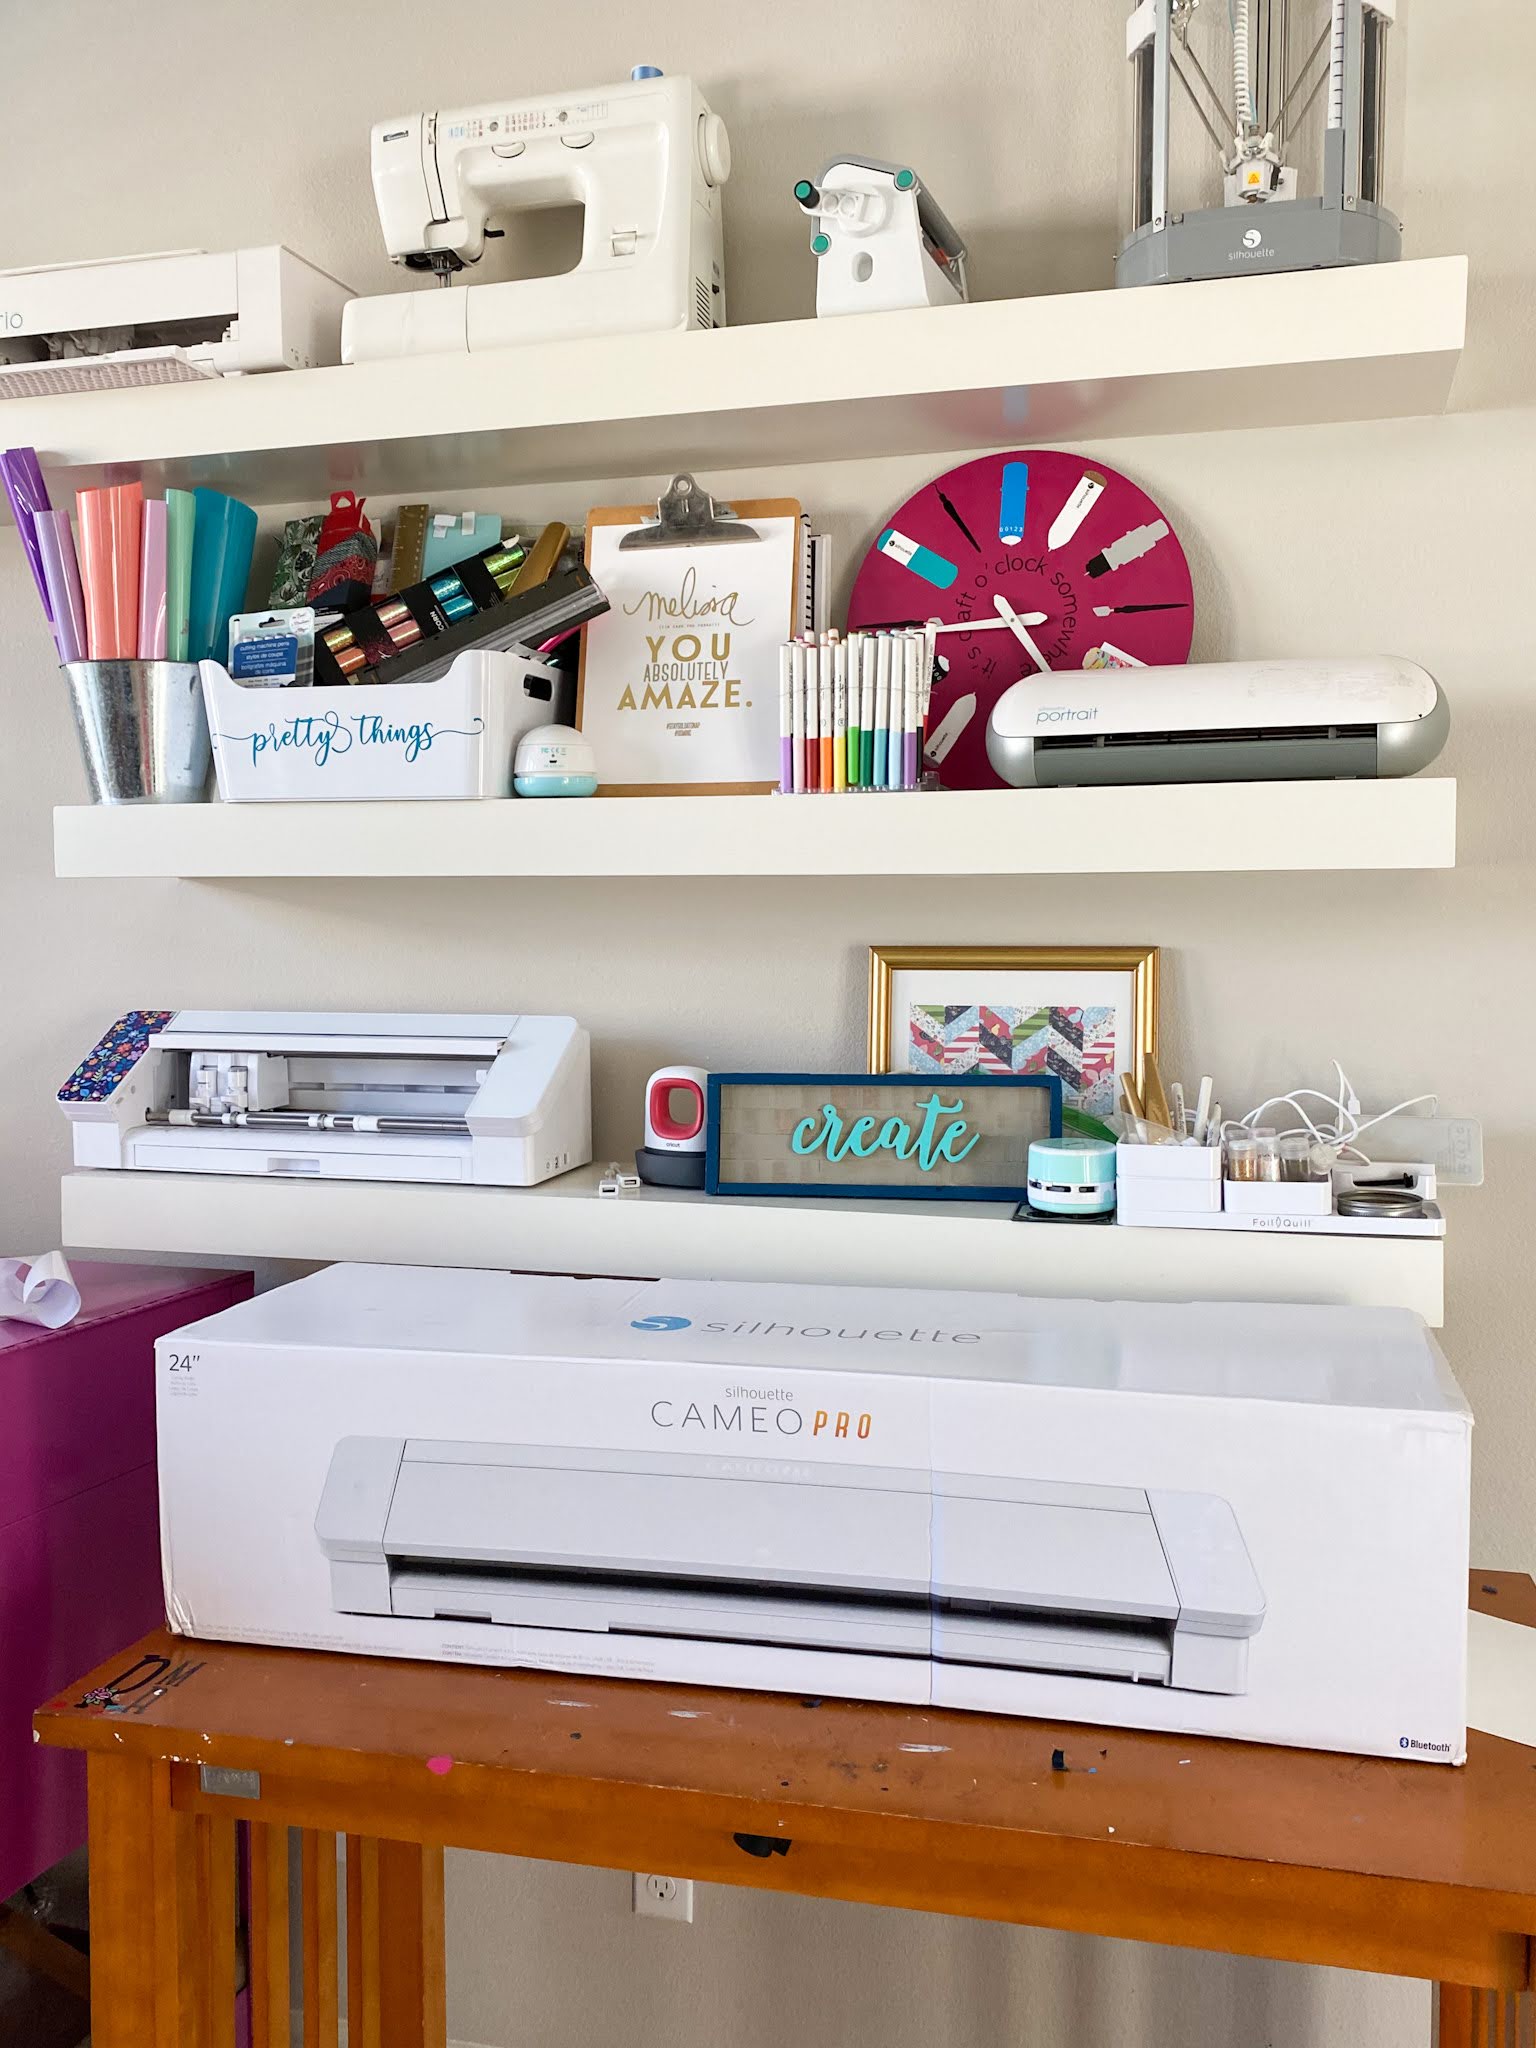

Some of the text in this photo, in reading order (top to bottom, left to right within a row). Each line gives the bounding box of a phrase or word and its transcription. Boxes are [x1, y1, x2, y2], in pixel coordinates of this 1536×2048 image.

[1227, 247, 1275, 261] silhouette
[622, 566, 756, 627] melissa
[955, 591, 977, 642] caft
[1020, 571, 1078, 678] somewhee
[645, 632, 731, 663] YOU
[643, 661, 729, 682] ABSOLUTELY
[616, 679, 753, 711] AMAZE.
[1036, 707, 1099, 725] portrait
[246, 710, 442, 767] pretty things
[791, 1093, 981, 1172] create
[1252, 1218, 1311, 1228] Foil Quill
[701, 1320, 983, 1345] silhouette
[725, 1384, 794, 1402] silhouette
[650, 1399, 873, 1440] CAMEO PRO
[1410, 1739, 1451, 1752] Bluetooth
